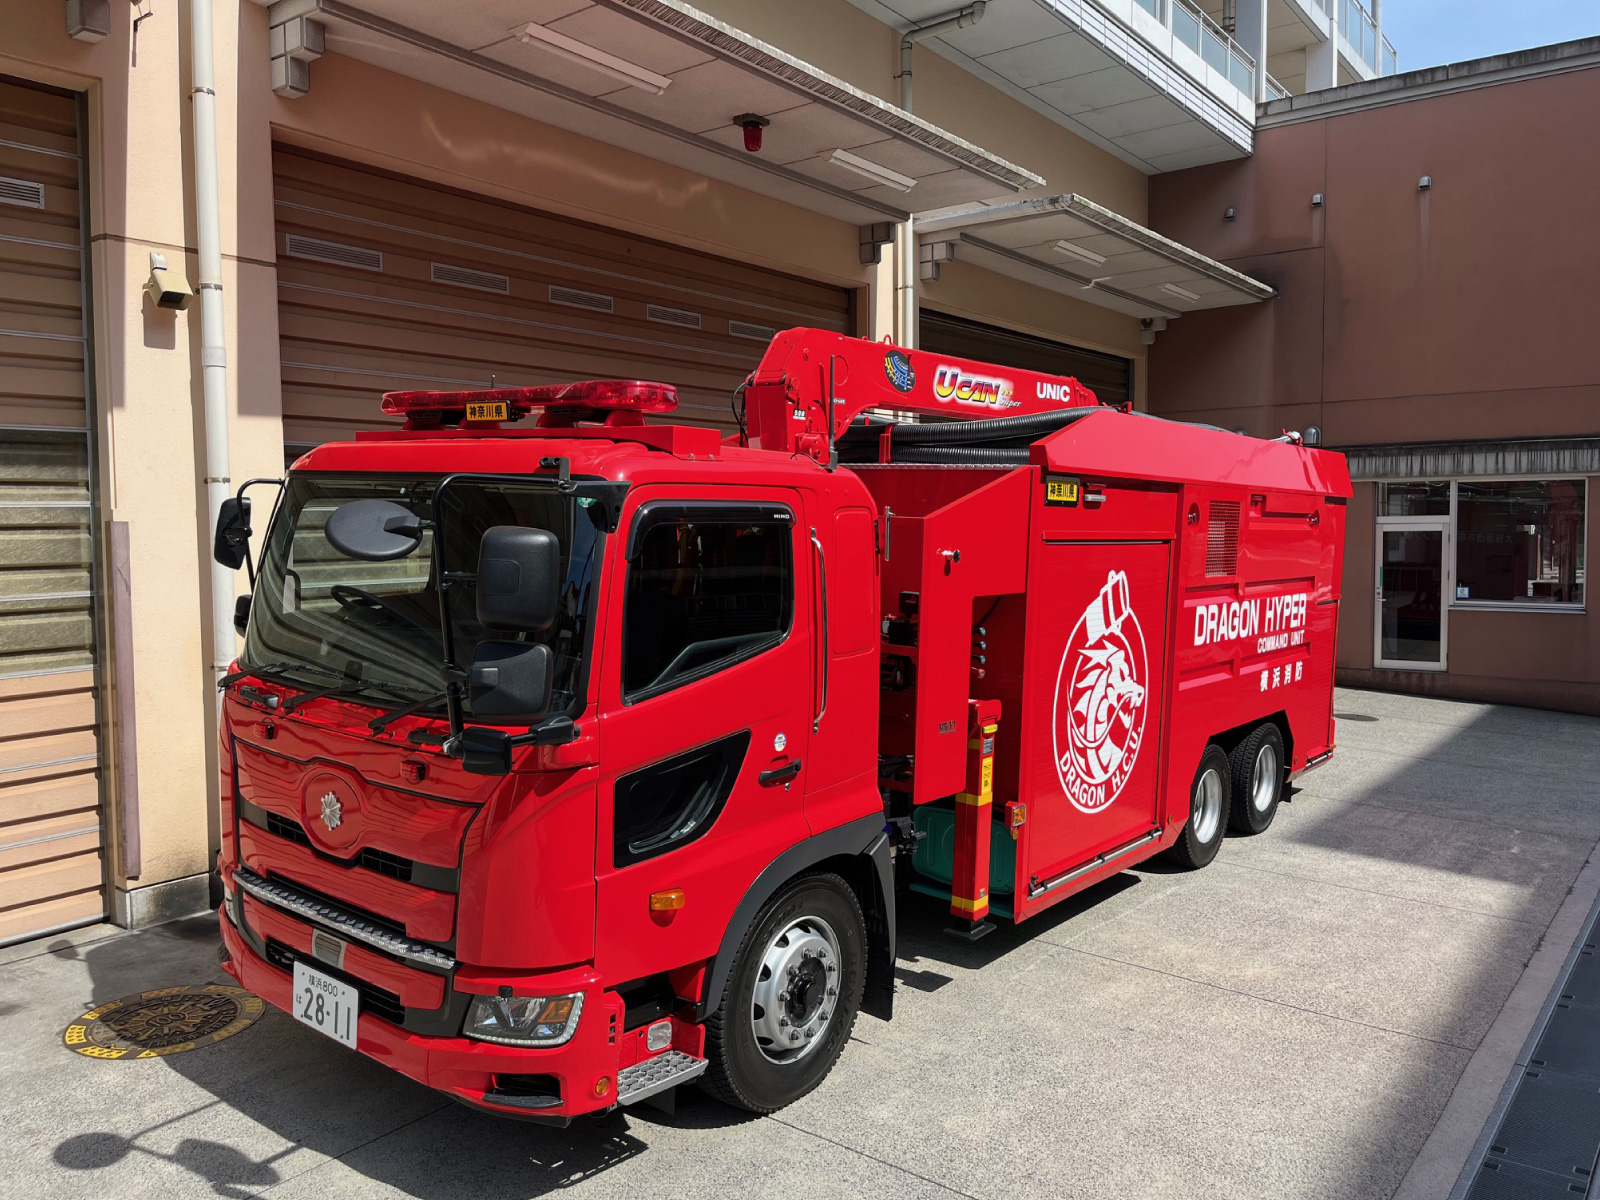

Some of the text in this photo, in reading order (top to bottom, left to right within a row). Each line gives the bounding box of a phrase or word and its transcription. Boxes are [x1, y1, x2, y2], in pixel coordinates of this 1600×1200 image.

[1000, 397, 1023, 409] Super
[1036, 381, 1071, 403] UNIC
[469, 405, 503, 418] 神奈川県
[1050, 484, 1075, 498] 神奈川県
[1194, 593, 1307, 646] DRAGON HYPER
[1257, 629, 1305, 653] COMMAND UNIT
[1259, 660, 1303, 692] 横浜消防
[1060, 750, 1106, 807] DRAGON
